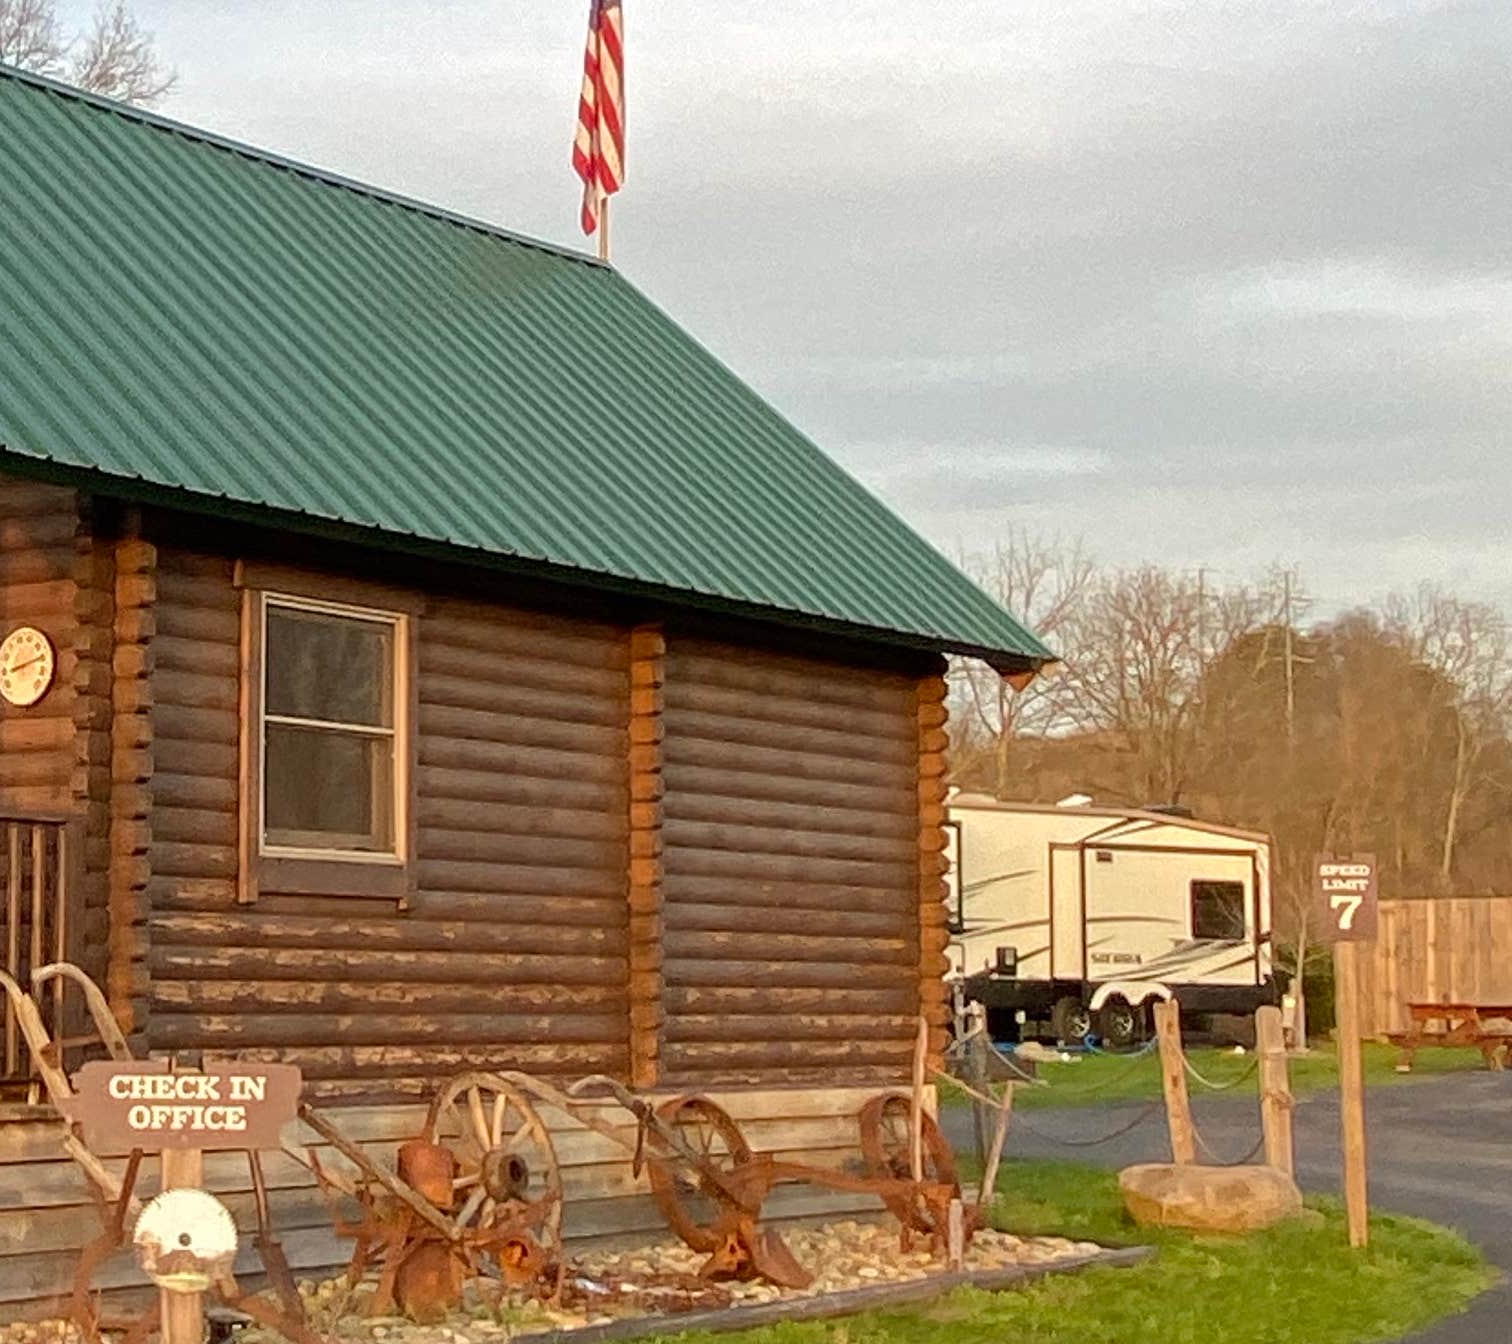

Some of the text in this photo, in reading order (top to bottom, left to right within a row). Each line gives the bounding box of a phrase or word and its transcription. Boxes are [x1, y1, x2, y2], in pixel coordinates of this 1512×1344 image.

[1319, 864, 1370, 877] SPEED
[1322, 879, 1369, 891] LIMIT
[1330, 895, 1363, 930] 7
[108, 1074, 267, 1101] CHECK IN
[128, 1105, 247, 1131] OFFICE
